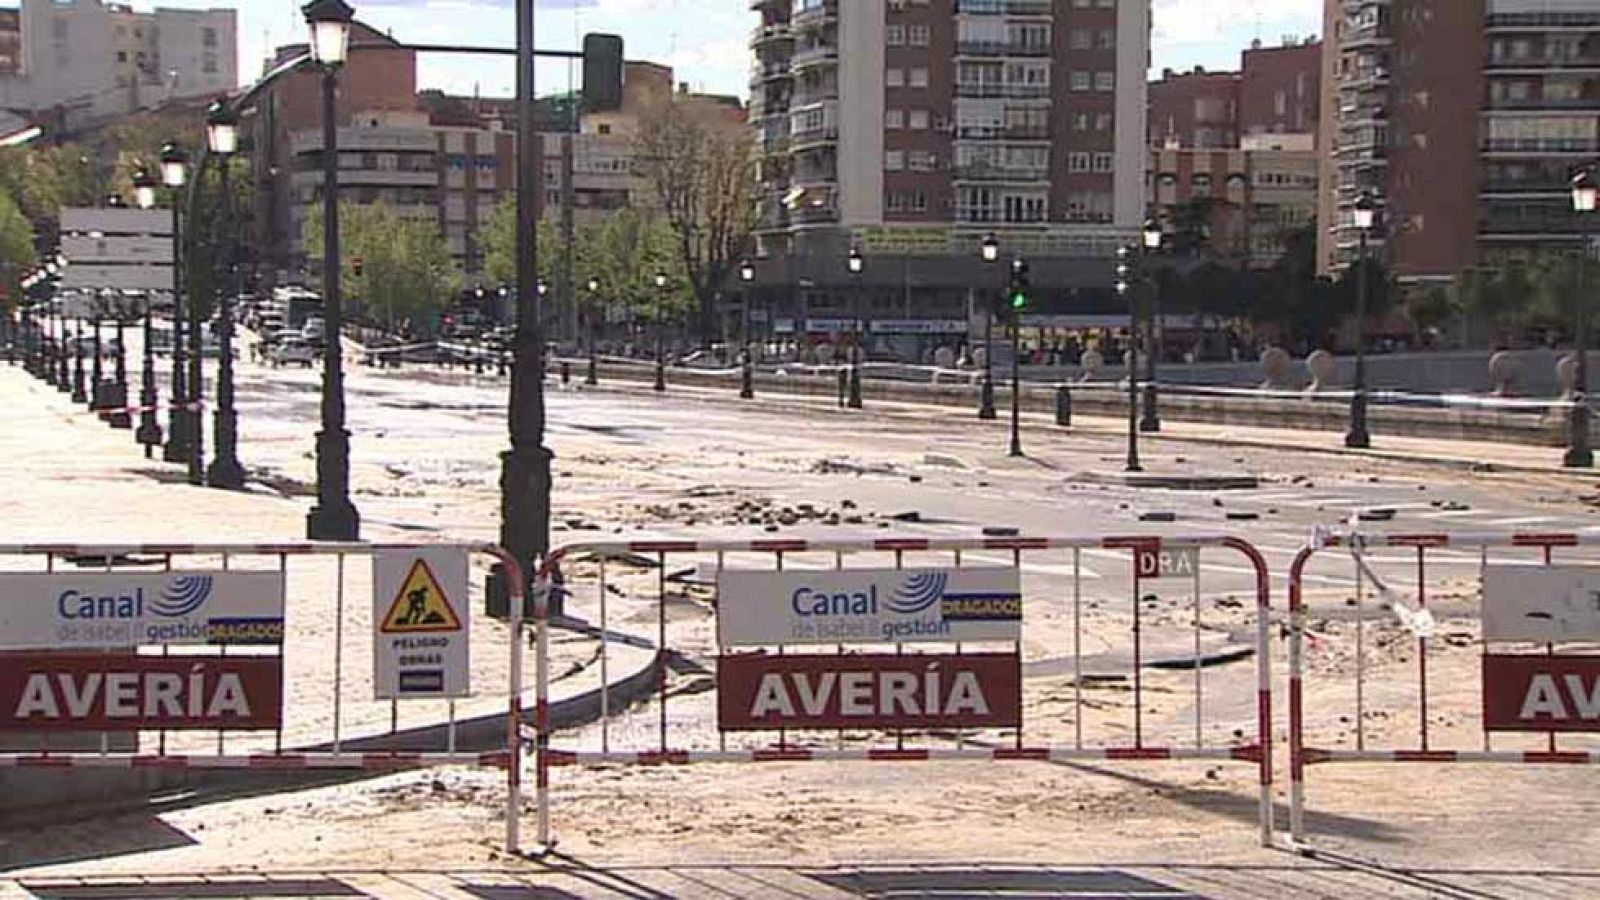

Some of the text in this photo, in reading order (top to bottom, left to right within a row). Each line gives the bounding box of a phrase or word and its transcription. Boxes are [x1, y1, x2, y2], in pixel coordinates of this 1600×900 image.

[1140, 551, 1193, 575] DRA
[58, 588, 142, 619] Canal
[792, 584, 876, 616] Canal
[392, 637, 448, 649] PELIGRO
[399, 653, 442, 666] OBRAS
[14, 662, 250, 718] AVERÍA
[750, 661, 989, 717] AVERÍA
